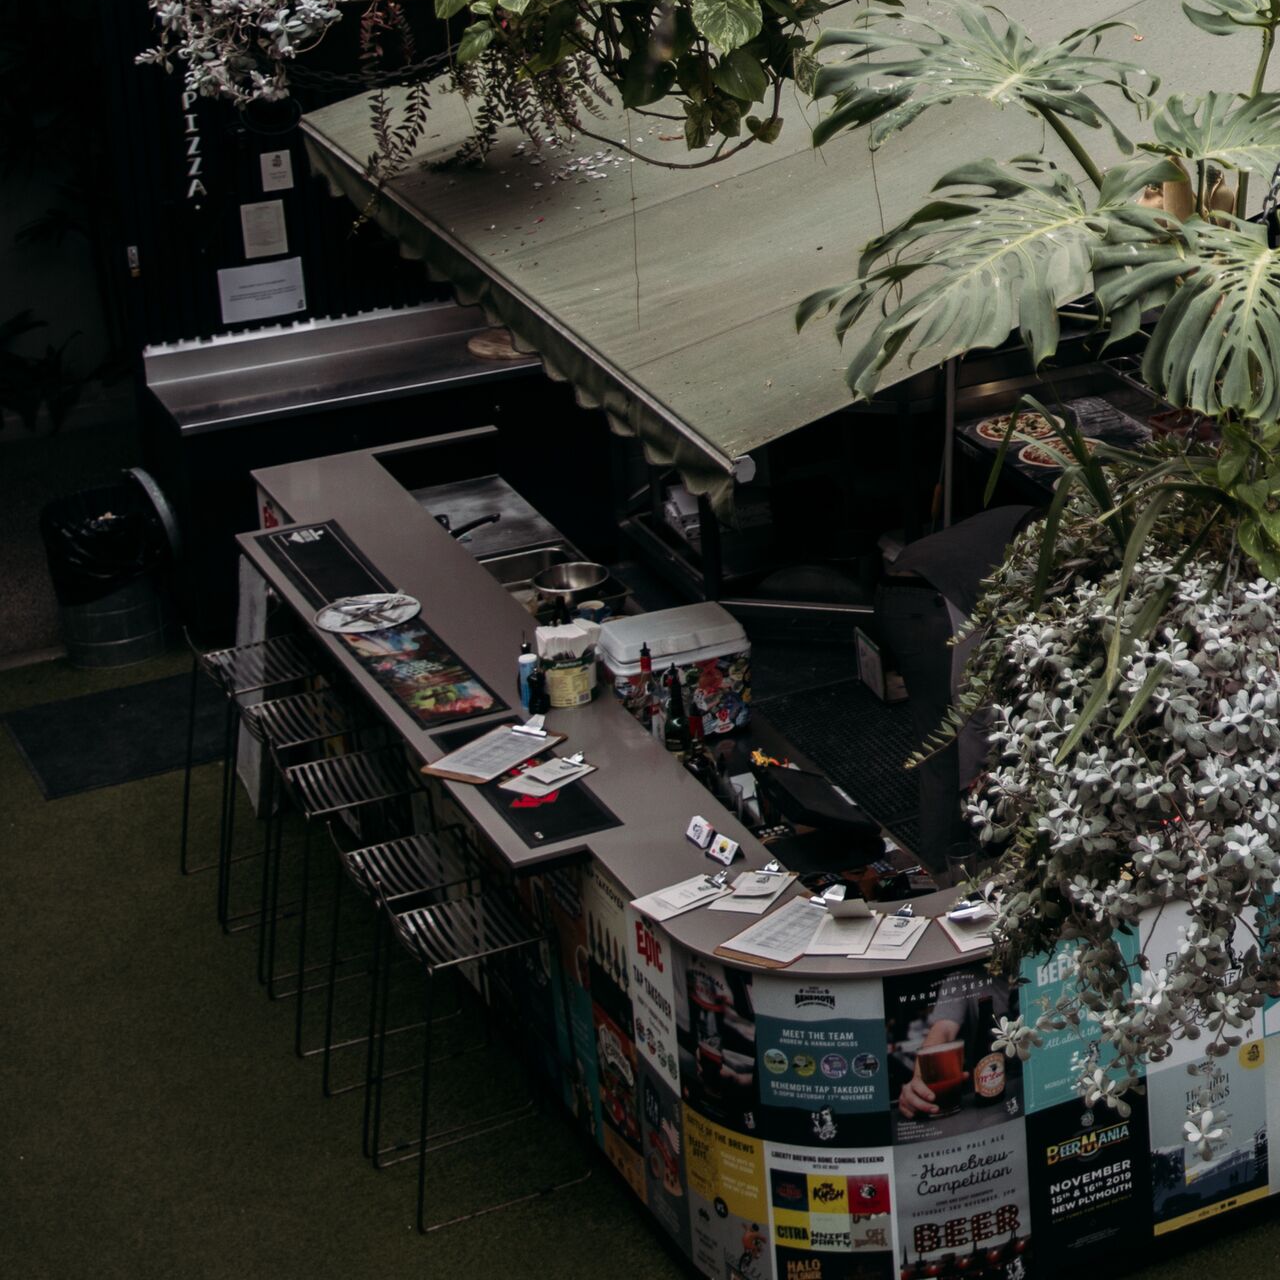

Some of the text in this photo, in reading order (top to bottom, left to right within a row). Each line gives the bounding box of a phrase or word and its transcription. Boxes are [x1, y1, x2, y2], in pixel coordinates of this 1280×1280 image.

[644, 975, 673, 1021] TAKEOVER
[899, 991, 937, 1004] WARM
[941, 986, 957, 996] UP
[961, 978, 993, 992] SESH
[782, 1029, 854, 1040] MEET THE TEAM
[771, 1080, 875, 1094] BEHEMOTH TAP TAKEOVER
[834, 1156, 856, 1164] COMING
[918, 1134, 1005, 1160] AMERICAN PALE ALE
[917, 1166, 1012, 1196] Competition
[1050, 1160, 1131, 1194] NOVEMBER
[1106, 1171, 1132, 1185] 2019
[1051, 1182, 1132, 1215] NEW PLYMOUTH
[914, 1204, 1021, 1253] BEER
[811, 1239, 852, 1247] PARTY
[787, 1258, 820, 1272] HALO
